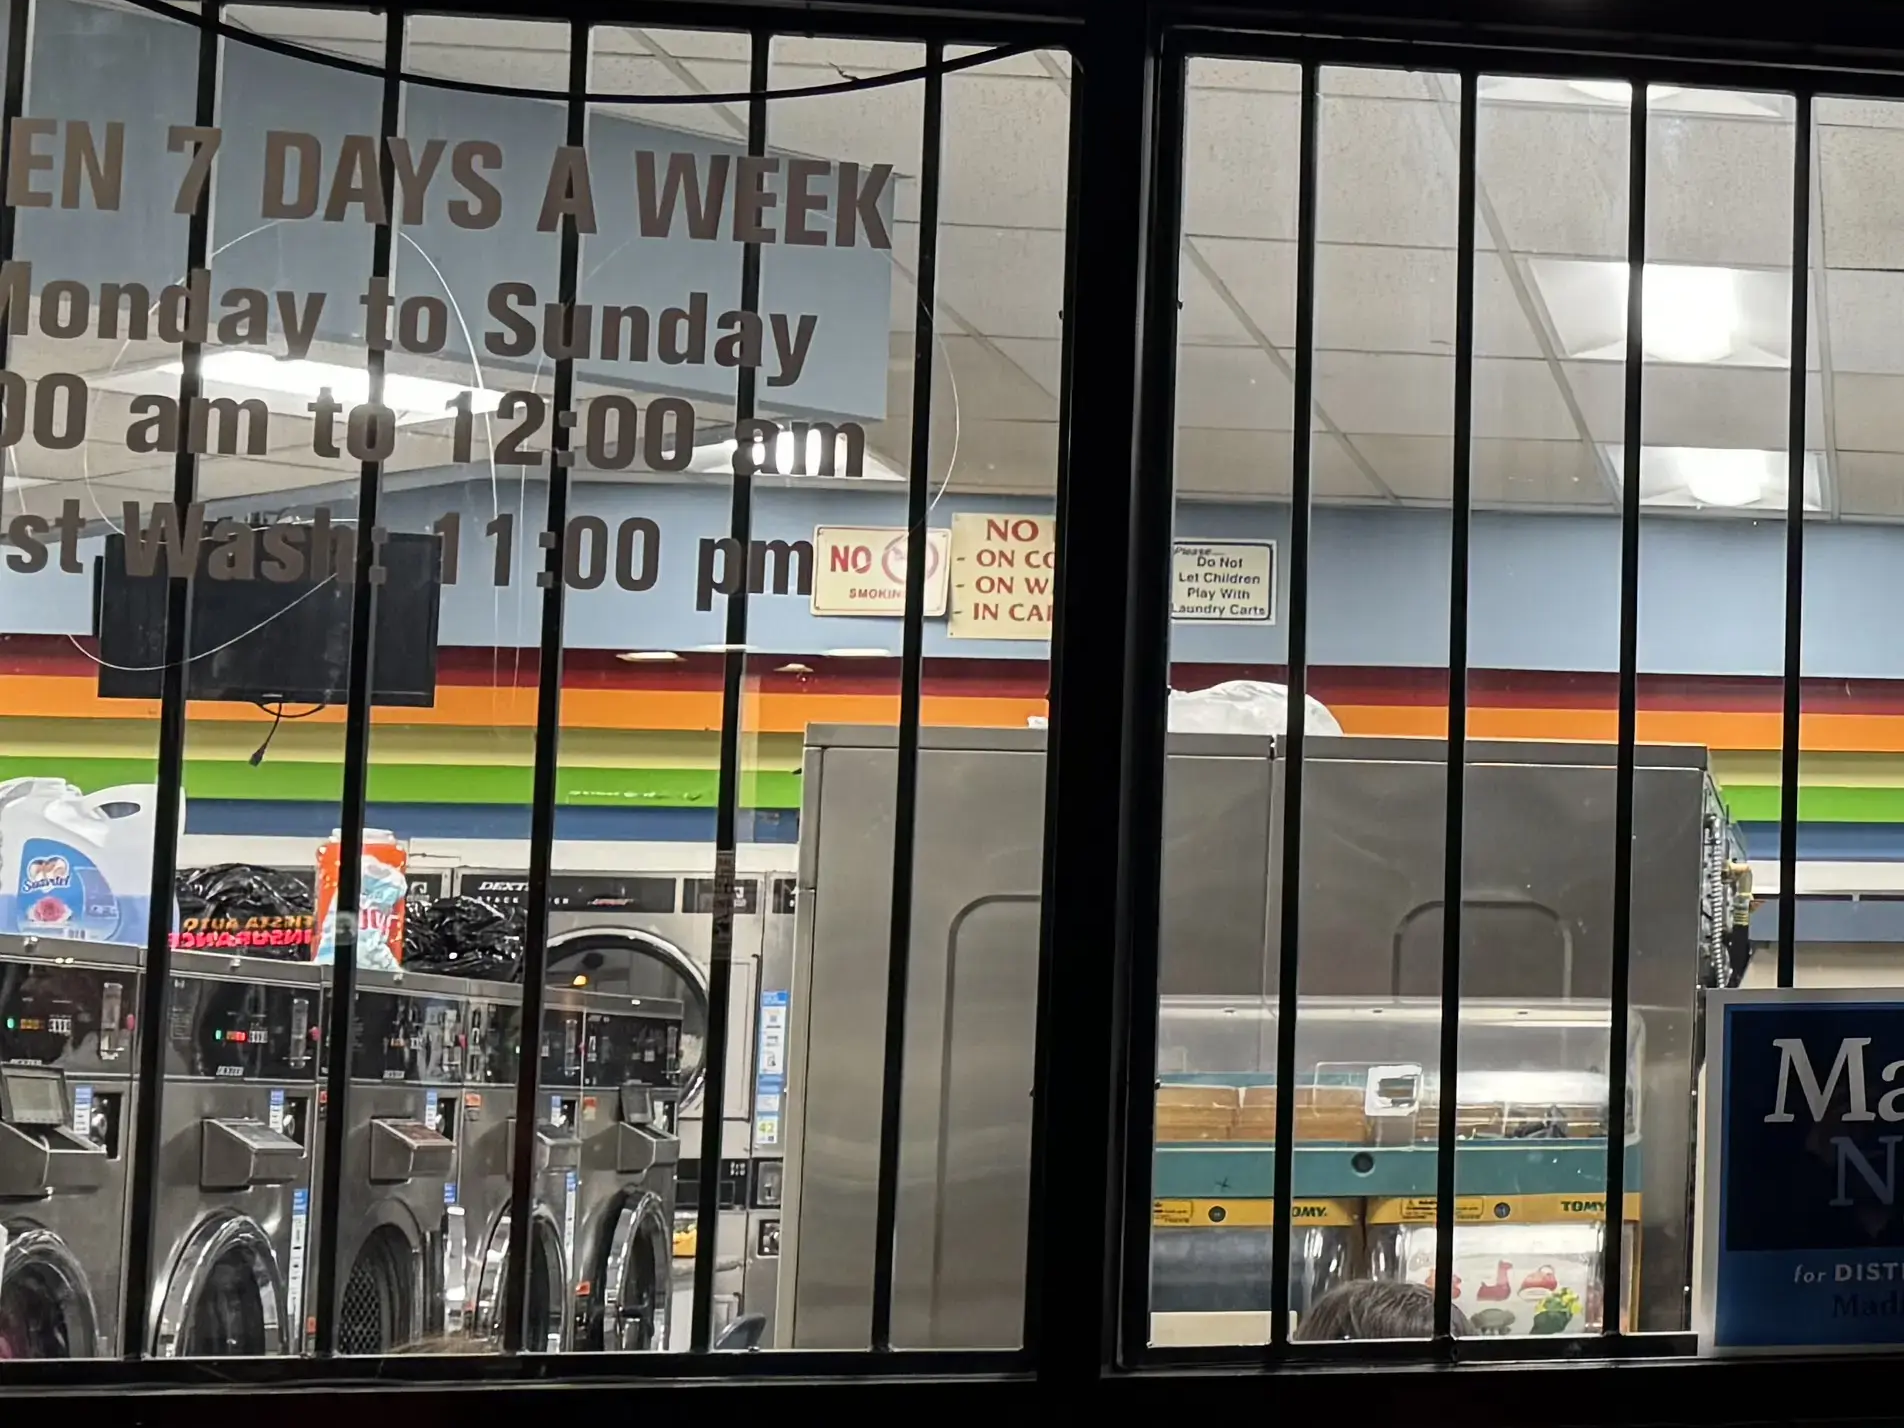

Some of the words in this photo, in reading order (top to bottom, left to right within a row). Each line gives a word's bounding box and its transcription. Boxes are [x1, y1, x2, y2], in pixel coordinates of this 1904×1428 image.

[166, 126, 222, 214] 7
[261, 130, 503, 232] DAYS
[536, 145, 598, 235] A
[635, 150, 895, 250] WEEK
[363, 276, 449, 354] to
[484, 281, 818, 388] Sunday
[126, 392, 269, 456] am
[308, 387, 396, 462] to
[448, 390, 696, 474] 12:00
[732, 415, 866, 479] am
[986, 519, 1039, 542] NO
[122, 501, 388, 584] Wash:
[435, 512, 661, 592] 11:00
[697, 527, 814, 612] pm
[830, 544, 872, 574] NO
[976, 549, 1015, 568] ON
[1197, 556, 1216, 567] Do
[1220, 557, 1243, 569] Not
[975, 575, 1014, 594] ON
[1179, 572, 1199, 583] Let
[1203, 572, 1261, 584] Children
[849, 587, 906, 601] SMOKIN
[1187, 587, 1216, 601] Play
[1220, 588, 1250, 600] With
[973, 602, 999, 621] IN
[1229, 604, 1266, 615] Carts
[1292, 1208, 1325, 1218] OMY
[1561, 1200, 1607, 1212] TOMY
[1793, 1264, 1826, 1284] for
